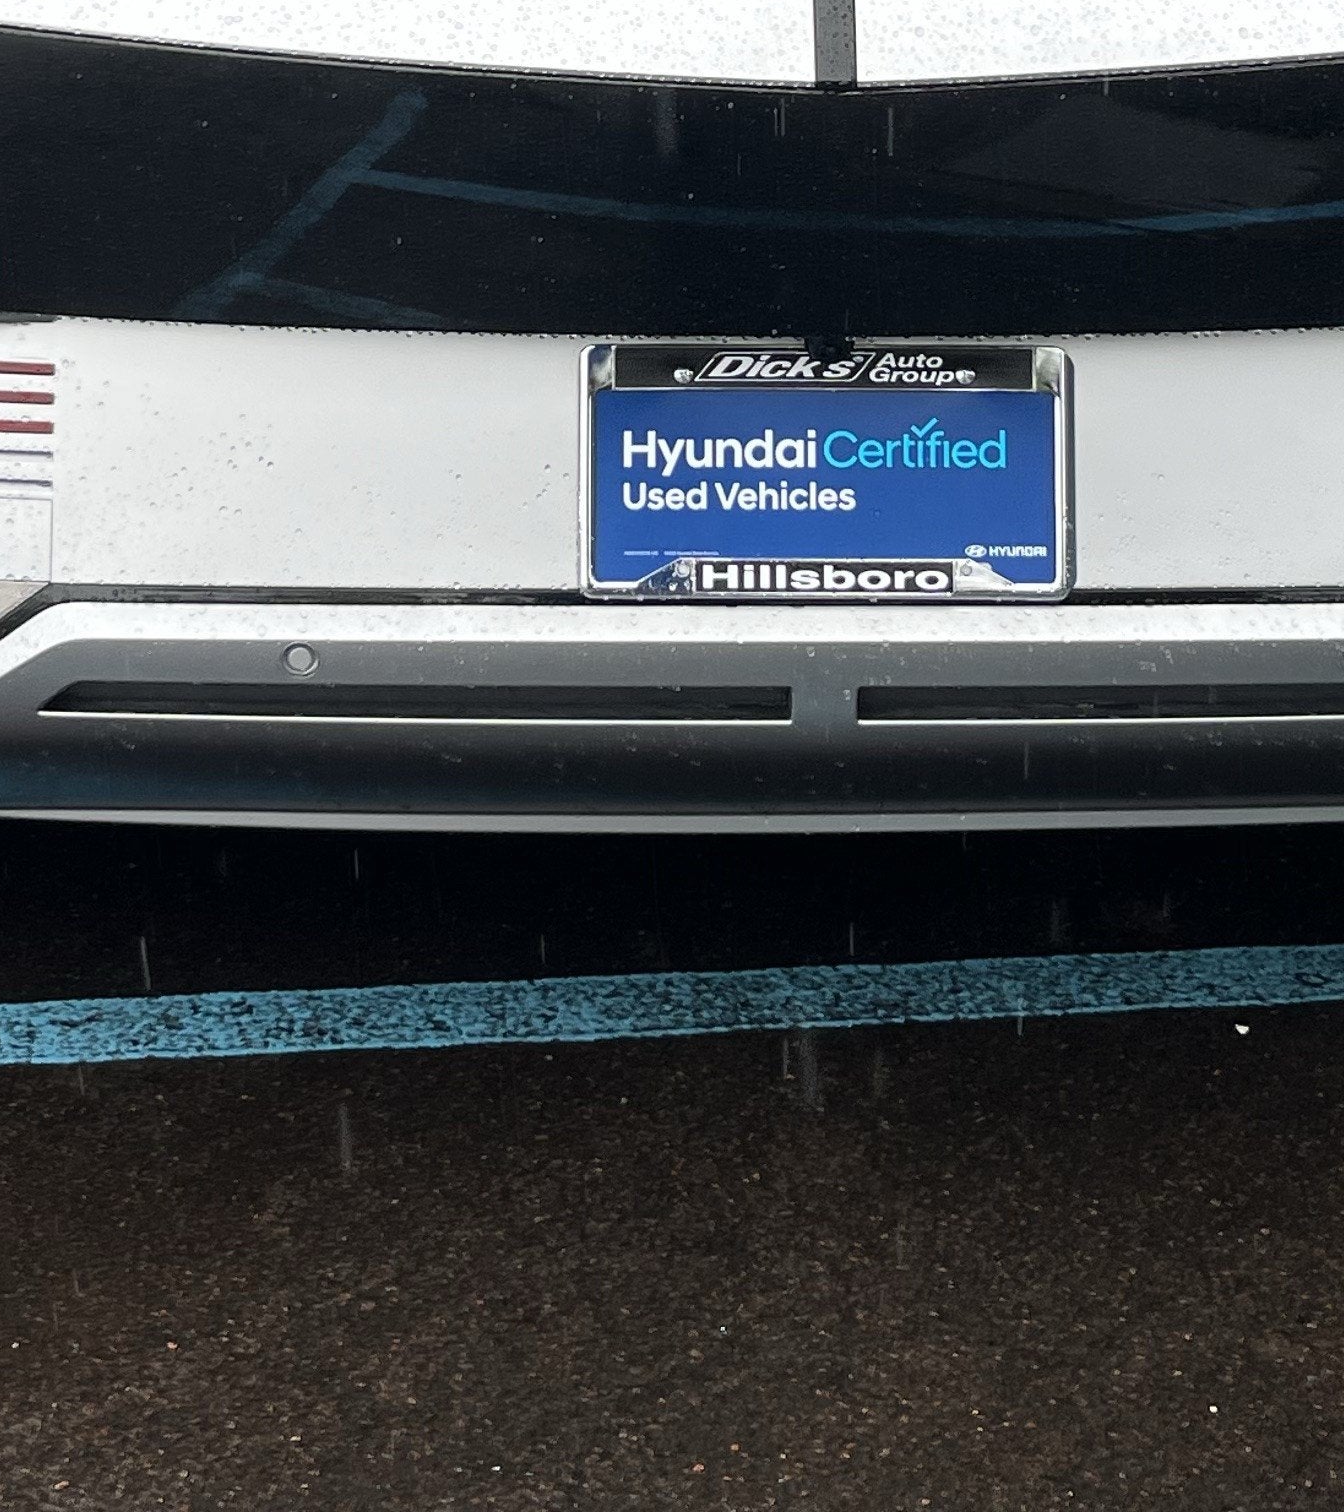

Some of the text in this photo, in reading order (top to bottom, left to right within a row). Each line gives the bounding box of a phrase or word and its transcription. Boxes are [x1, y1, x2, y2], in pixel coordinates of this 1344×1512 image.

[707, 354, 857, 378] Dicks
[875, 352, 944, 369] Auto
[868, 368, 955, 386] Group
[622, 417, 1007, 477] Hyundai Certified
[622, 481, 857, 511] Used Vehicles
[988, 545, 1048, 557] HYUNDAI
[701, 563, 950, 590] Hillsboro
